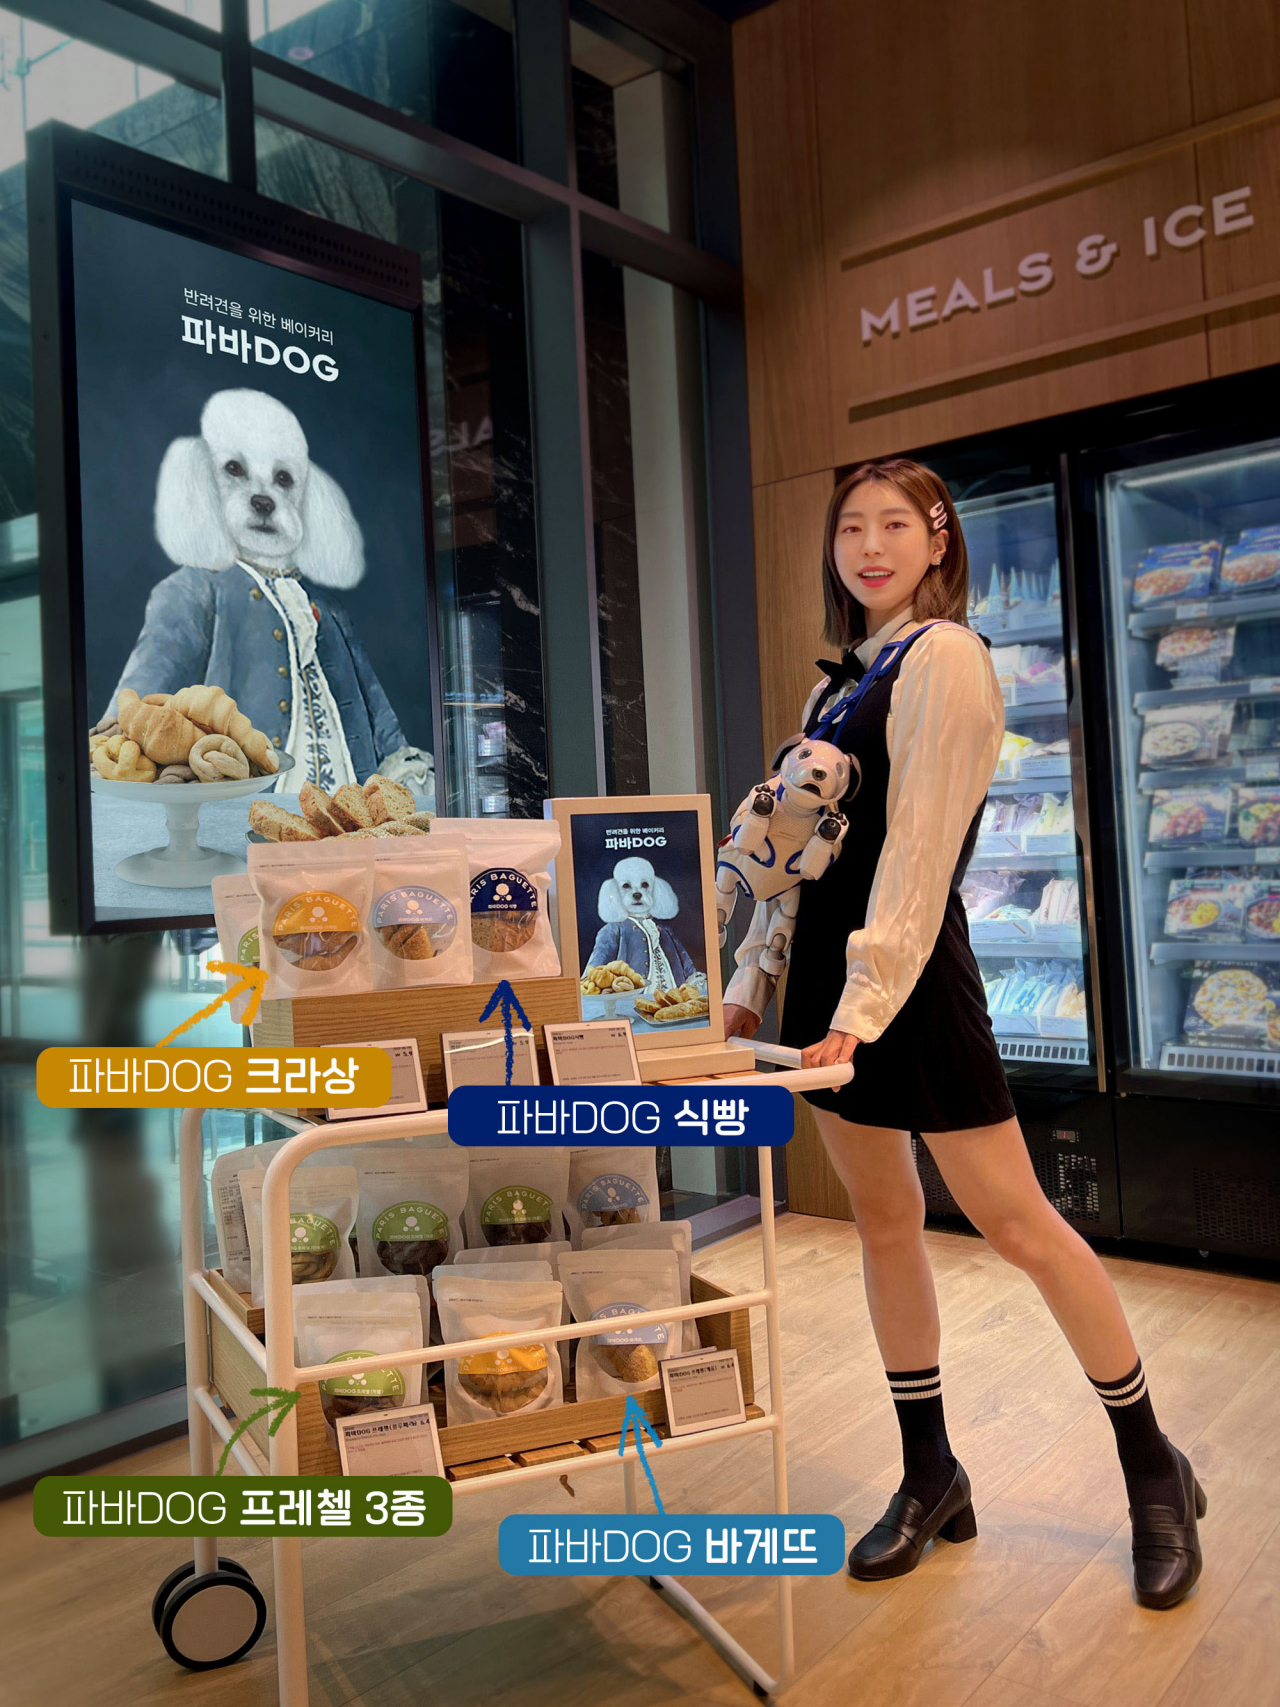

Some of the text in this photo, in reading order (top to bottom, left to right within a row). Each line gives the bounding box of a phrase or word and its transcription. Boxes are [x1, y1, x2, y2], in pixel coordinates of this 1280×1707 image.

[860, 186, 1255, 344] MEALS & ICE
[183, 287, 334, 346] 반려견을 위한 베이커리
[181, 314, 340, 383] 파바DOG
[605, 836, 667, 851] 파바DOG
[376, 890, 454, 924] PARIS BAGUETTE
[490, 873, 537, 908] BAGUETTE
[277, 895, 358, 932] PARIS BAGUETTE
[240, 931, 259, 961] PARIS
[484, 1195, 503, 1223] PARIS
[582, 1177, 646, 1210] PARIS BAGUETTE
[290, 1217, 336, 1246] BAGUETTE
[375, 1206, 445, 1239] PARIS BAGUETTE
